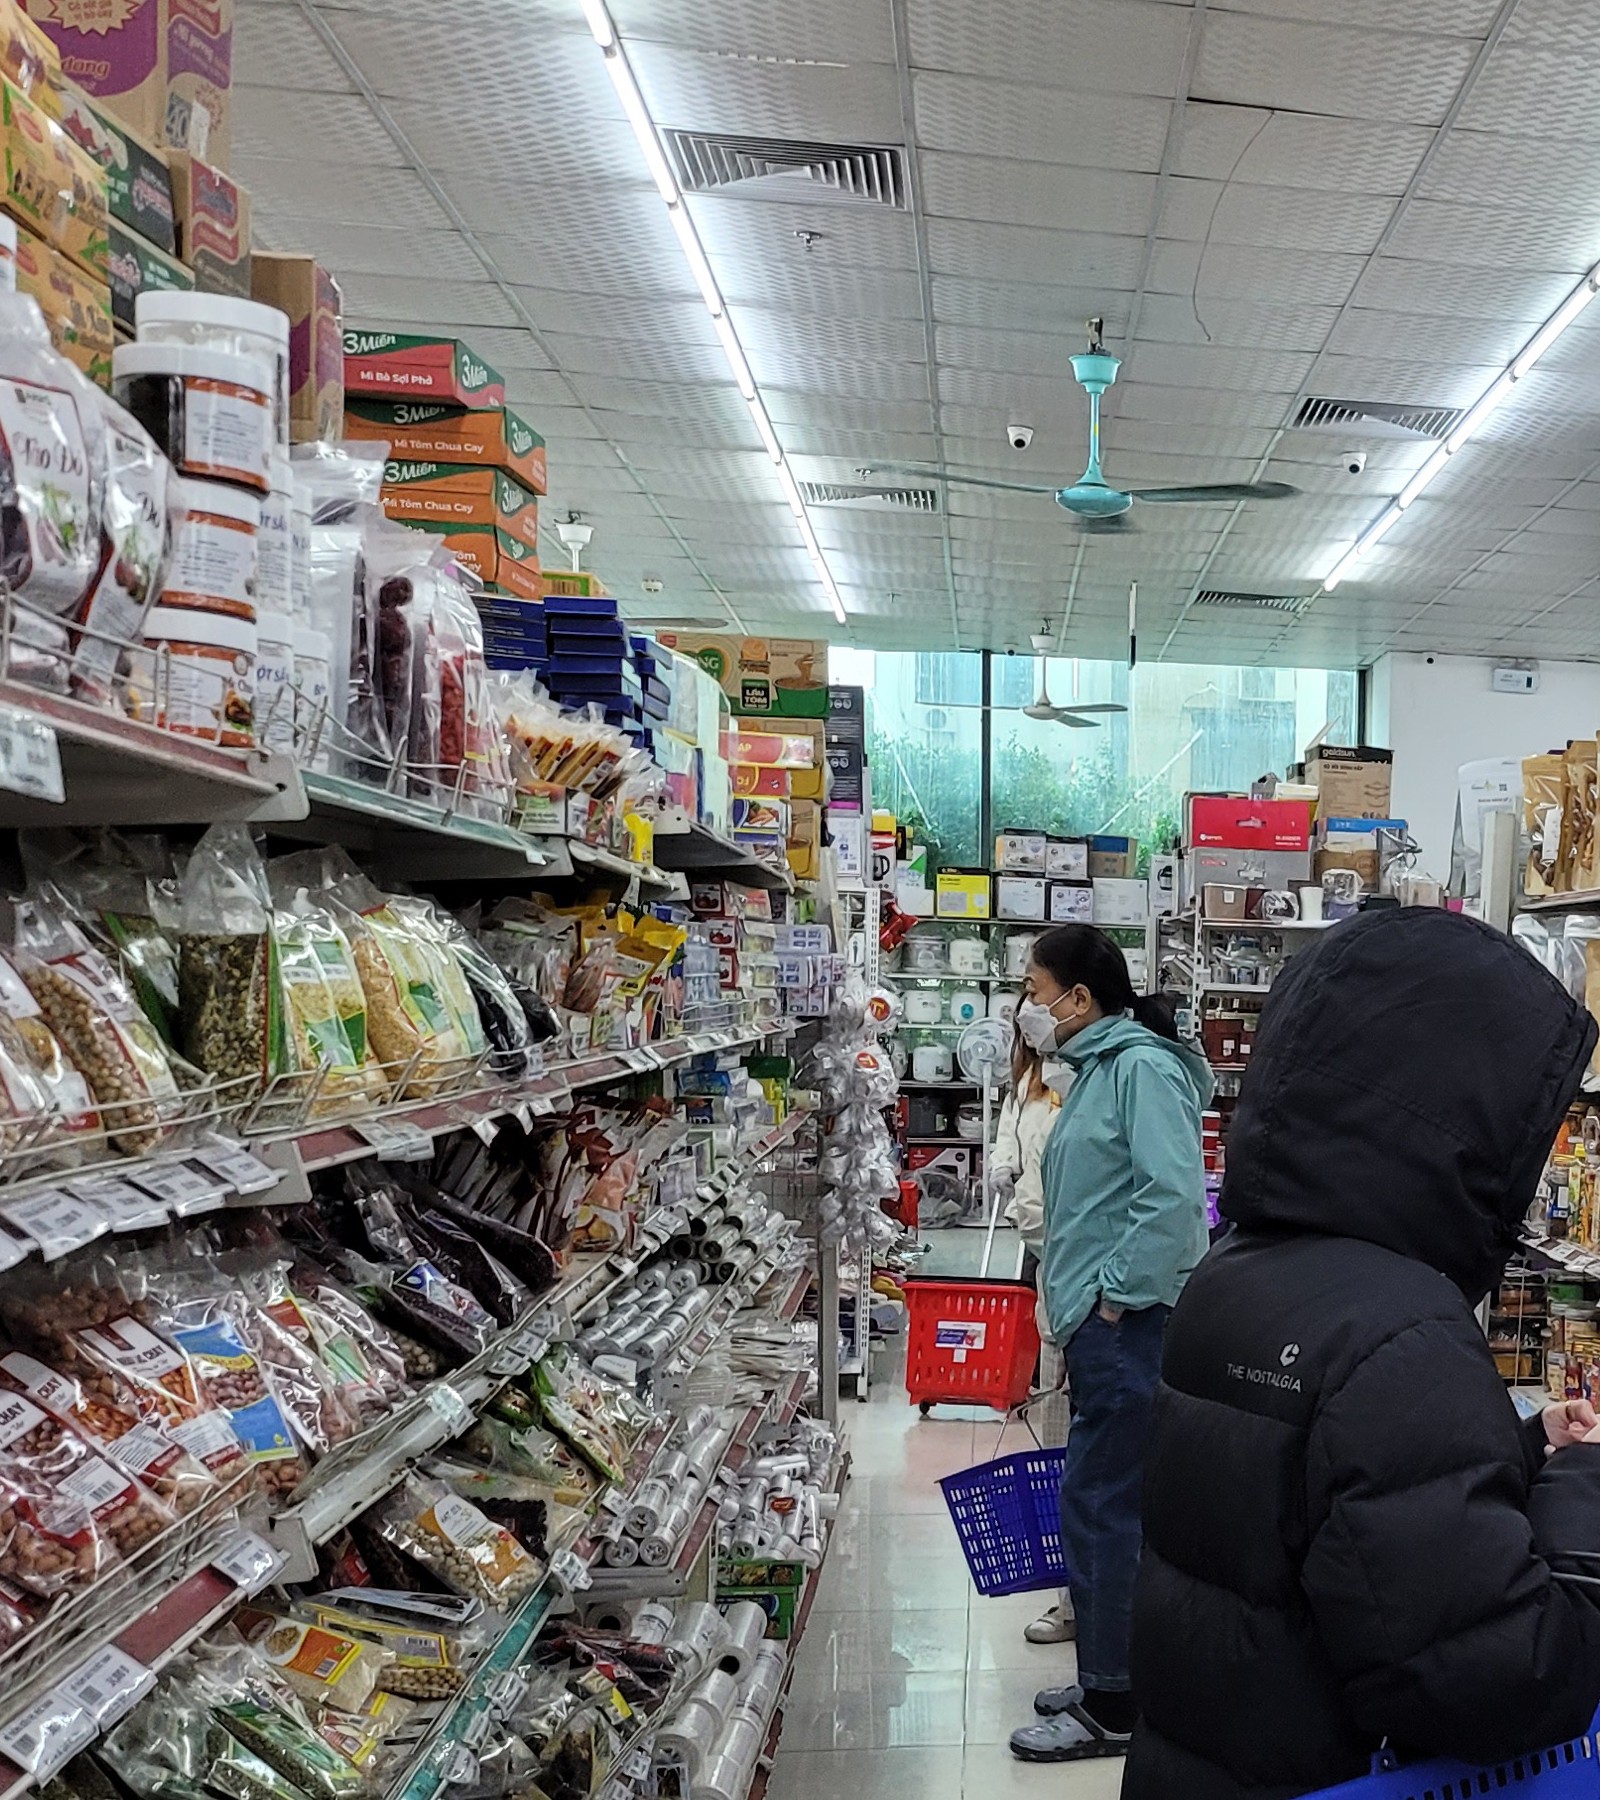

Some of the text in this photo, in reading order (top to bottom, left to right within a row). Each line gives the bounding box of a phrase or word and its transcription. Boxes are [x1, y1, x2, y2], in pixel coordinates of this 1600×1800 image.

[435, 441, 462, 452] Chua
[464, 443, 484, 454] Cay
[425, 501, 451, 511] Chua
[454, 503, 474, 514] Cay
[1322, 748, 1356, 757] goldsun
[1227, 1363, 1301, 1393] THE NOSTALGIA
